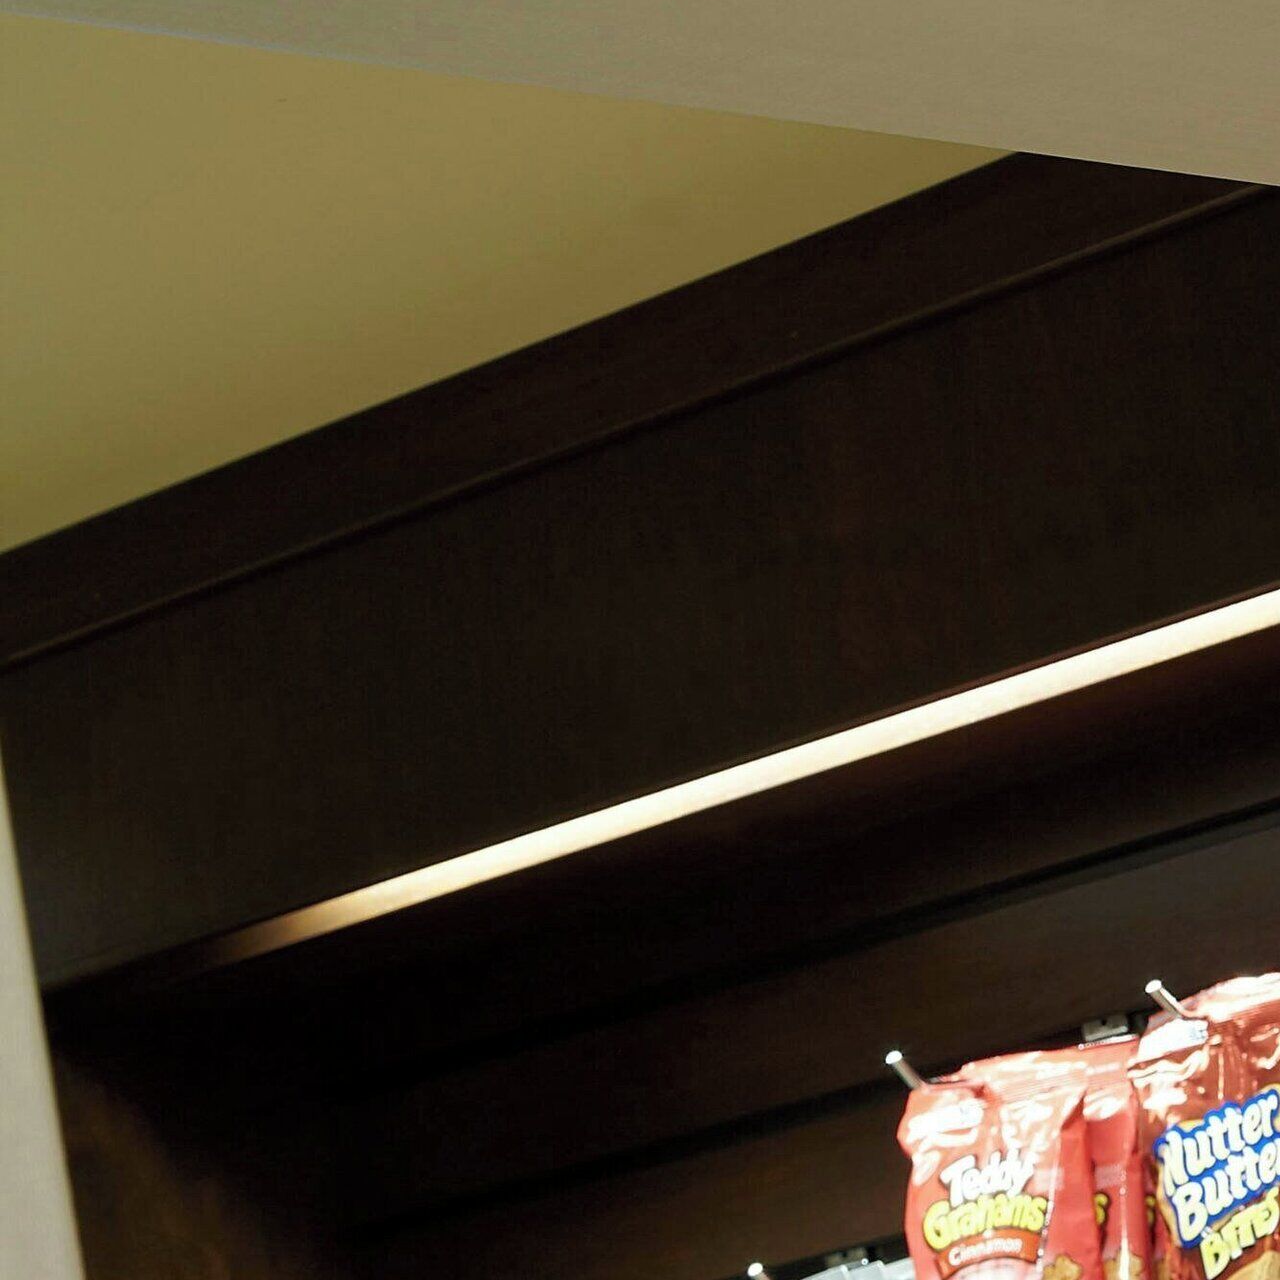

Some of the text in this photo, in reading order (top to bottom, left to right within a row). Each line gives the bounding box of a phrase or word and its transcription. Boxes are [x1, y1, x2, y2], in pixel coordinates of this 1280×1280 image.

[1159, 1092, 1280, 1198] Nutter
[939, 1145, 1036, 1208] Teddy
[922, 1192, 1050, 1251] Grahams
[948, 1237, 1025, 1267] Cinnamon
